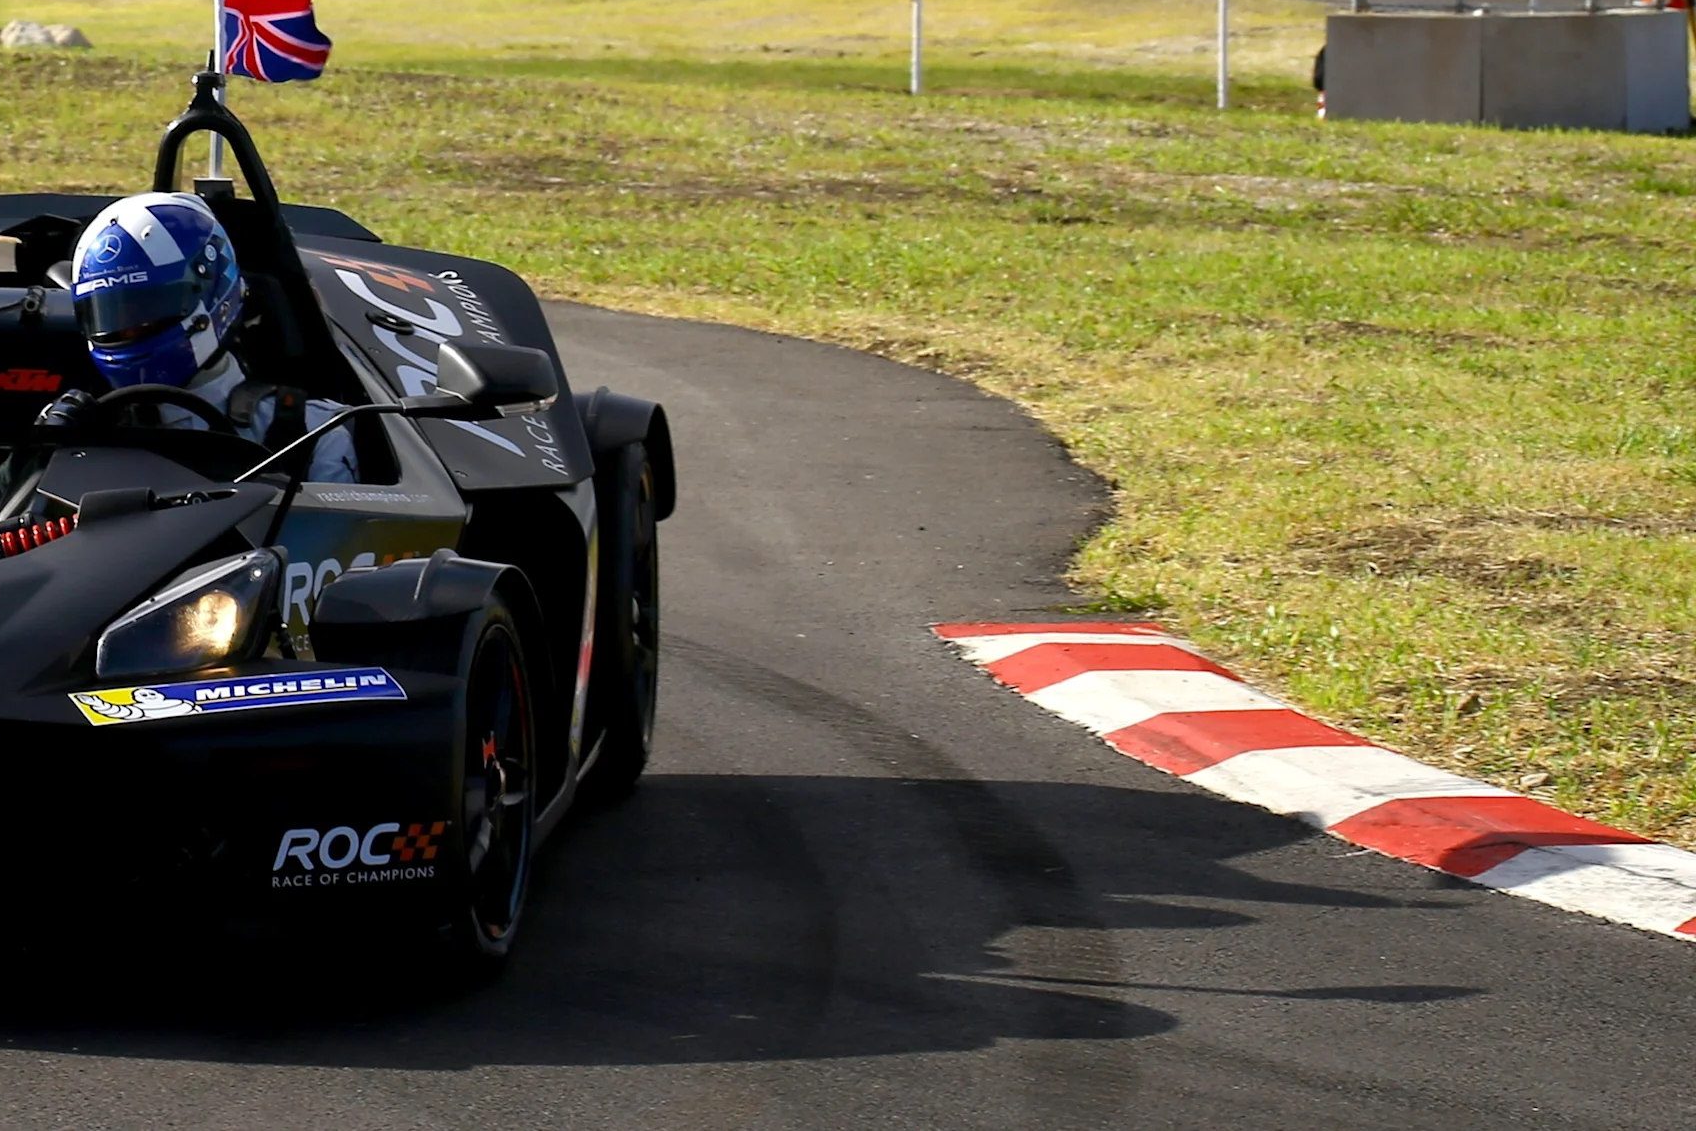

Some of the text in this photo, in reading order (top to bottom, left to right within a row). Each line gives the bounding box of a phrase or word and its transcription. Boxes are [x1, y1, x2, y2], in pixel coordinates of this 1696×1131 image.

[91, 271, 149, 291] AMG
[195, 673, 387, 702] MICHELIN
[272, 822, 401, 871] ROC
[272, 865, 436, 889] RACE OF CHAMPIONS
